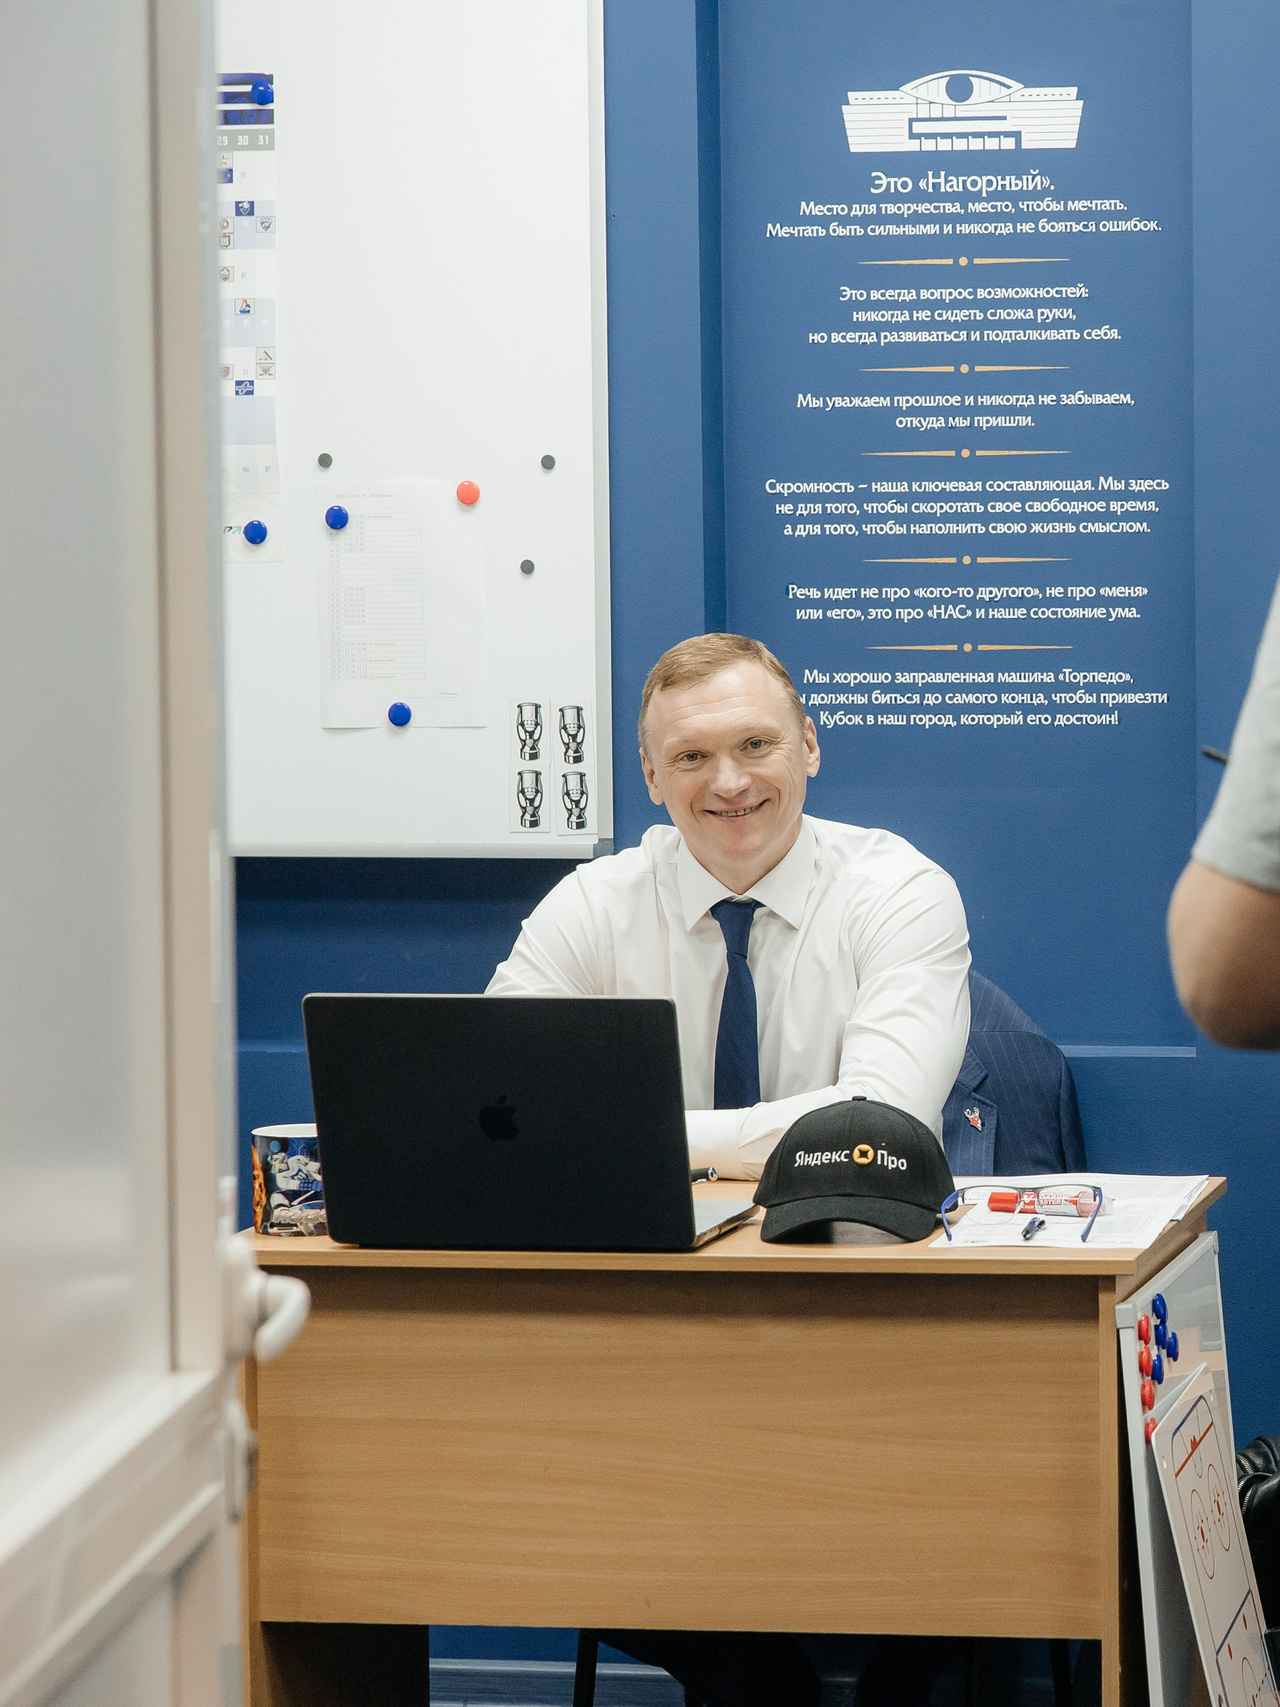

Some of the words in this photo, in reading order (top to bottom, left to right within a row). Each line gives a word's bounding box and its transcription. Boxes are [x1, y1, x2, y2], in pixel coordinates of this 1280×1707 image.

[237, 135, 249, 146] 30
[258, 135, 269, 145] 31
[870, 171, 913, 194] Это
[918, 168, 1055, 198] «Нагорный».
[799, 201, 849, 216] Место
[850, 203, 877, 218] для
[879, 202, 965, 218] творчества,
[967, 200, 1016, 214] место,
[1018, 196, 1065, 212] чтобы
[1066, 199, 1128, 212] мечтать.
[765, 222, 827, 238] Мечтать
[828, 221, 865, 237] быть
[866, 223, 940, 236] сильными
[943, 223, 953, 235] и
[955, 222, 1015, 236] никогда
[1016, 222, 1036, 234] не
[1038, 218, 1096, 233] бояться
[1098, 216, 1162, 232] ошибок.
[839, 286, 867, 302] Это
[869, 288, 918, 303] всегда
[919, 288, 975, 304] вопрос
[976, 282, 1089, 300] возможностей:
[852, 309, 911, 324] никогда
[912, 309, 932, 321] не
[933, 309, 985, 323] сидеть
[986, 308, 1035, 321] сложа
[1037, 307, 1077, 324] руки,
[808, 332, 828, 344] но
[830, 331, 879, 346] всегда
[880, 330, 968, 347] развиваться
[970, 330, 981, 342] и
[983, 329, 1081, 344] подталкивать
[1083, 324, 1122, 340] себя.
[796, 393, 824, 408] Мы
[825, 396, 891, 412] уважаем
[893, 395, 962, 411] прошлое
[964, 395, 975, 406] и
[977, 394, 1036, 408] никогда
[1038, 394, 1057, 406] не
[1059, 390, 1135, 406] забываем,
[895, 416, 946, 432] откуда
[947, 416, 971, 428] мы
[974, 415, 1035, 431] пришли.
[765, 478, 855, 497] Скромность
[871, 481, 910, 493] наша
[911, 480, 983, 493] ключевая
[985, 479, 1096, 494] составляющая.
[1097, 476, 1125, 491] Мы
[1127, 479, 1170, 493] здесь
[775, 503, 794, 515] не
[795, 503, 823, 517] для
[824, 502, 860, 516] того,
[863, 499, 908, 514] чтобы
[911, 501, 985, 517] скоротать
[987, 501, 1023, 513] свое
[1024, 497, 1107, 515] свободное
[1109, 500, 1160, 516] время,
[783, 524, 794, 536] а
[794, 524, 822, 538] для
[823, 523, 859, 537] того,
[861, 520, 907, 535] чтобы
[910, 523, 986, 535] наполнить
[988, 522, 1028, 534] свою
[1029, 522, 1077, 534] жизнь
[1078, 521, 1151, 533] смыслом.
[788, 584, 822, 599] Речь
[823, 587, 859, 601] идет
[860, 587, 879, 599] не
[881, 587, 911, 602] про
[913, 587, 975, 599] «кого-то
[976, 586, 1043, 602] другого»,
[1045, 586, 1065, 598] не
[1067, 586, 1097, 601] про
[1099, 586, 1149, 598] «меня»
[795, 608, 823, 620] или
[826, 608, 865, 622] «его»,
[867, 608, 893, 620] это
[895, 608, 924, 624] про
[926, 604, 973, 620] «НАС»
[975, 608, 986, 619] и
[988, 607, 1028, 619] наше
[1029, 607, 1107, 619] состояние
[1108, 607, 1141, 622] ума.
[803, 669, 830, 684] Мы
[832, 672, 892, 687] хорошо
[894, 672, 995, 687] заправленная
[997, 671, 1056, 683] машина
[1058, 668, 1134, 687] «Торпедо»,
[808, 693, 869, 707] должны
[871, 689, 921, 705] биться
[922, 693, 943, 707] до
[944, 693, 998, 705] самого
[1001, 692, 1049, 706] конца,
[1051, 689, 1097, 704] чтобы
[1100, 692, 1168, 708] привезти
[819, 710, 864, 729] Кубок
[866, 714, 875, 725] в
[877, 714, 907, 726] наш
[910, 714, 957, 729] город,
[960, 710, 1024, 729] который
[1026, 713, 1052, 725] его
[1053, 710, 1119, 727] достоин!
[794, 1150, 850, 1167] Яндекс
[877, 1149, 908, 1170] Про
